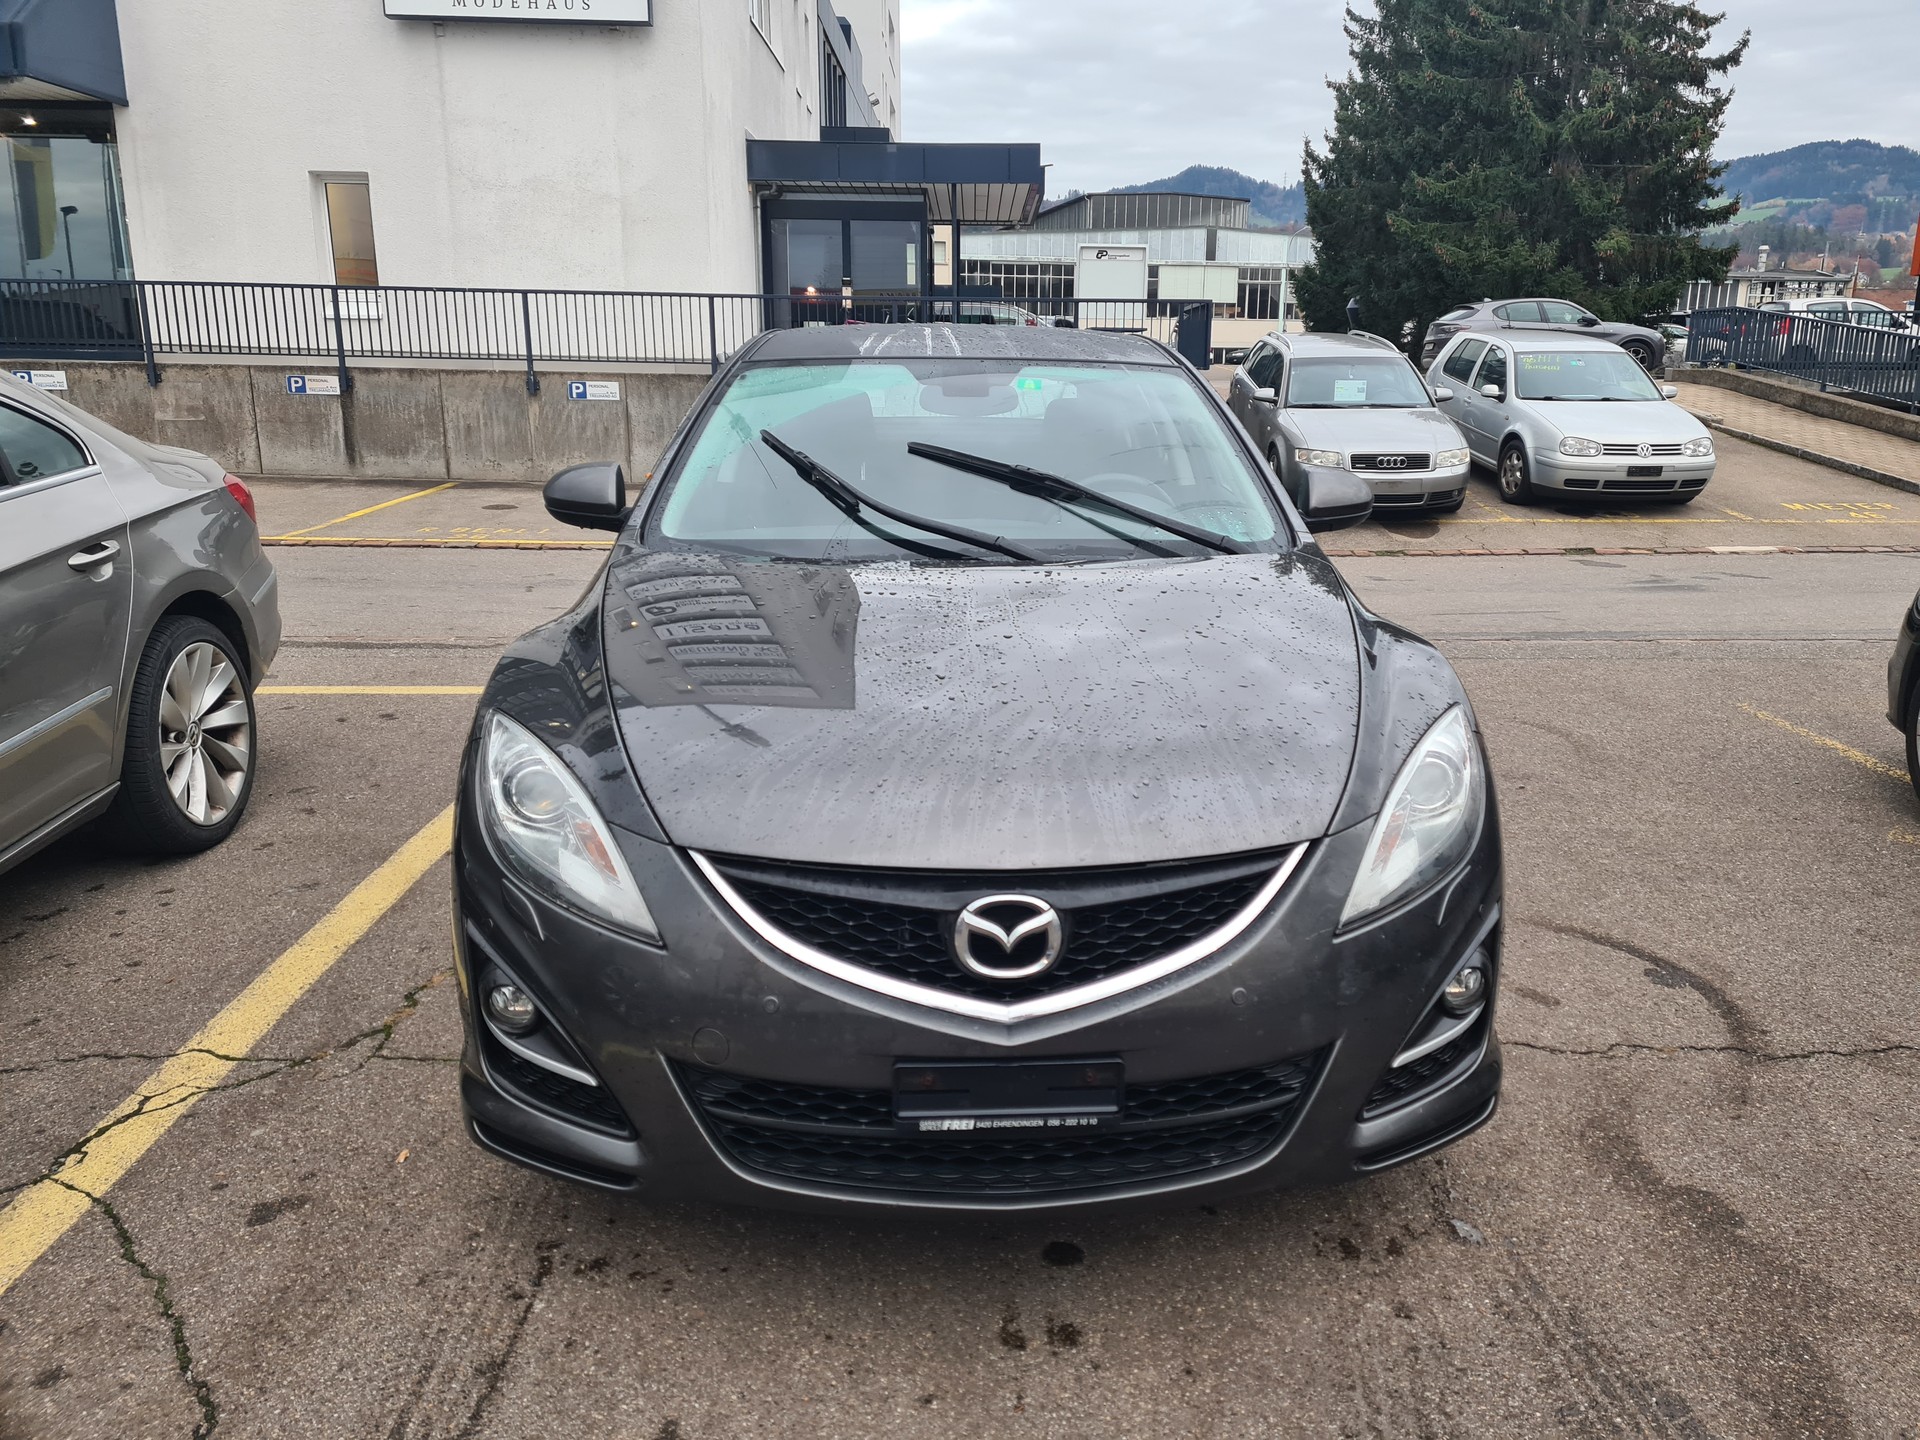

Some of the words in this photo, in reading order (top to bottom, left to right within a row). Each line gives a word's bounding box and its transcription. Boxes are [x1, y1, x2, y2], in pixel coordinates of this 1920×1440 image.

[452, 0, 591, 10] MODEHAUS
[290, 377, 303, 392] P
[571, 383, 584, 398] P
[1780, 502, 1900, 510] MIETER
[942, 1119, 975, 1131] FREI
[976, 1121, 992, 1129] 5420
[993, 1120, 1044, 1128] EHRENDINGEN
